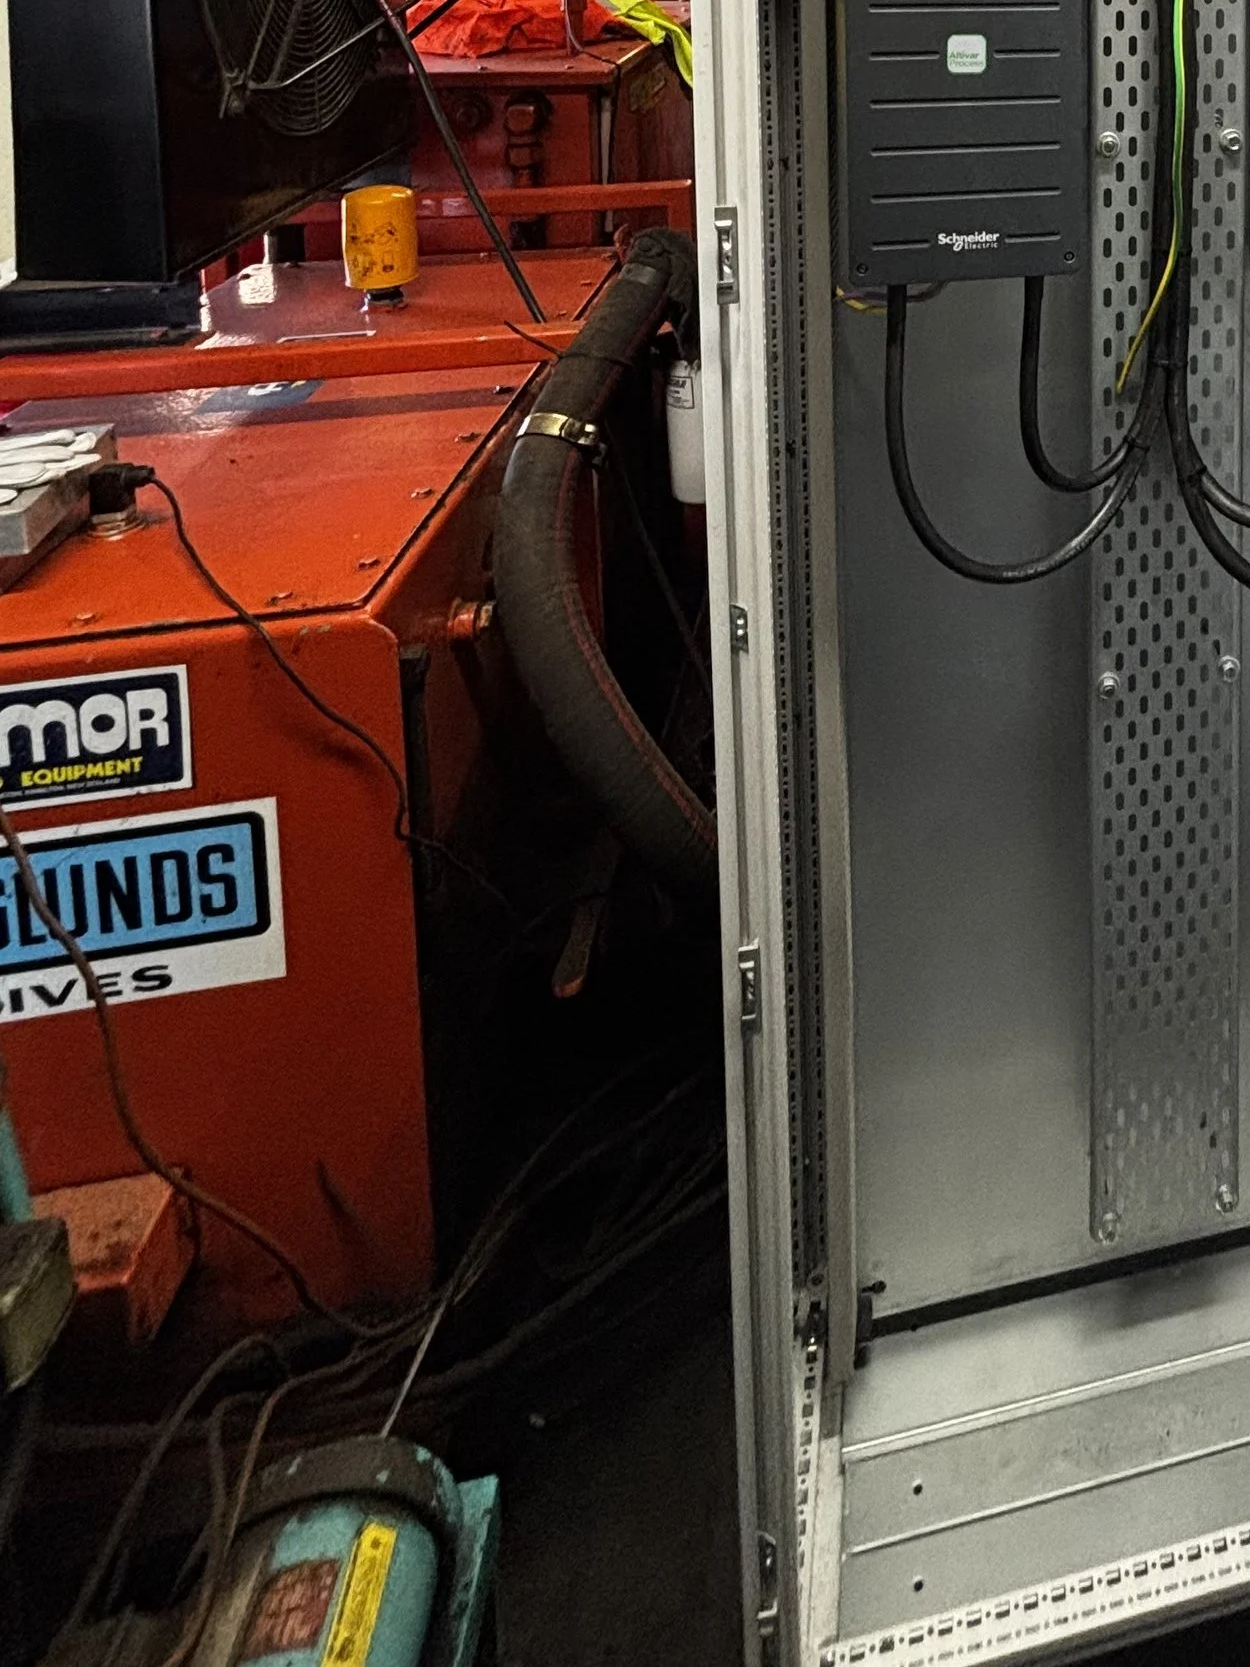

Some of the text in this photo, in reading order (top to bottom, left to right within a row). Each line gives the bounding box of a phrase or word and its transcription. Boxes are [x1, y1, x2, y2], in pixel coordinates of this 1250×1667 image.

[938, 231, 1000, 248] Schneider
[964, 242, 998, 250] Electric
[20, 756, 143, 787] EQUIPMENT
